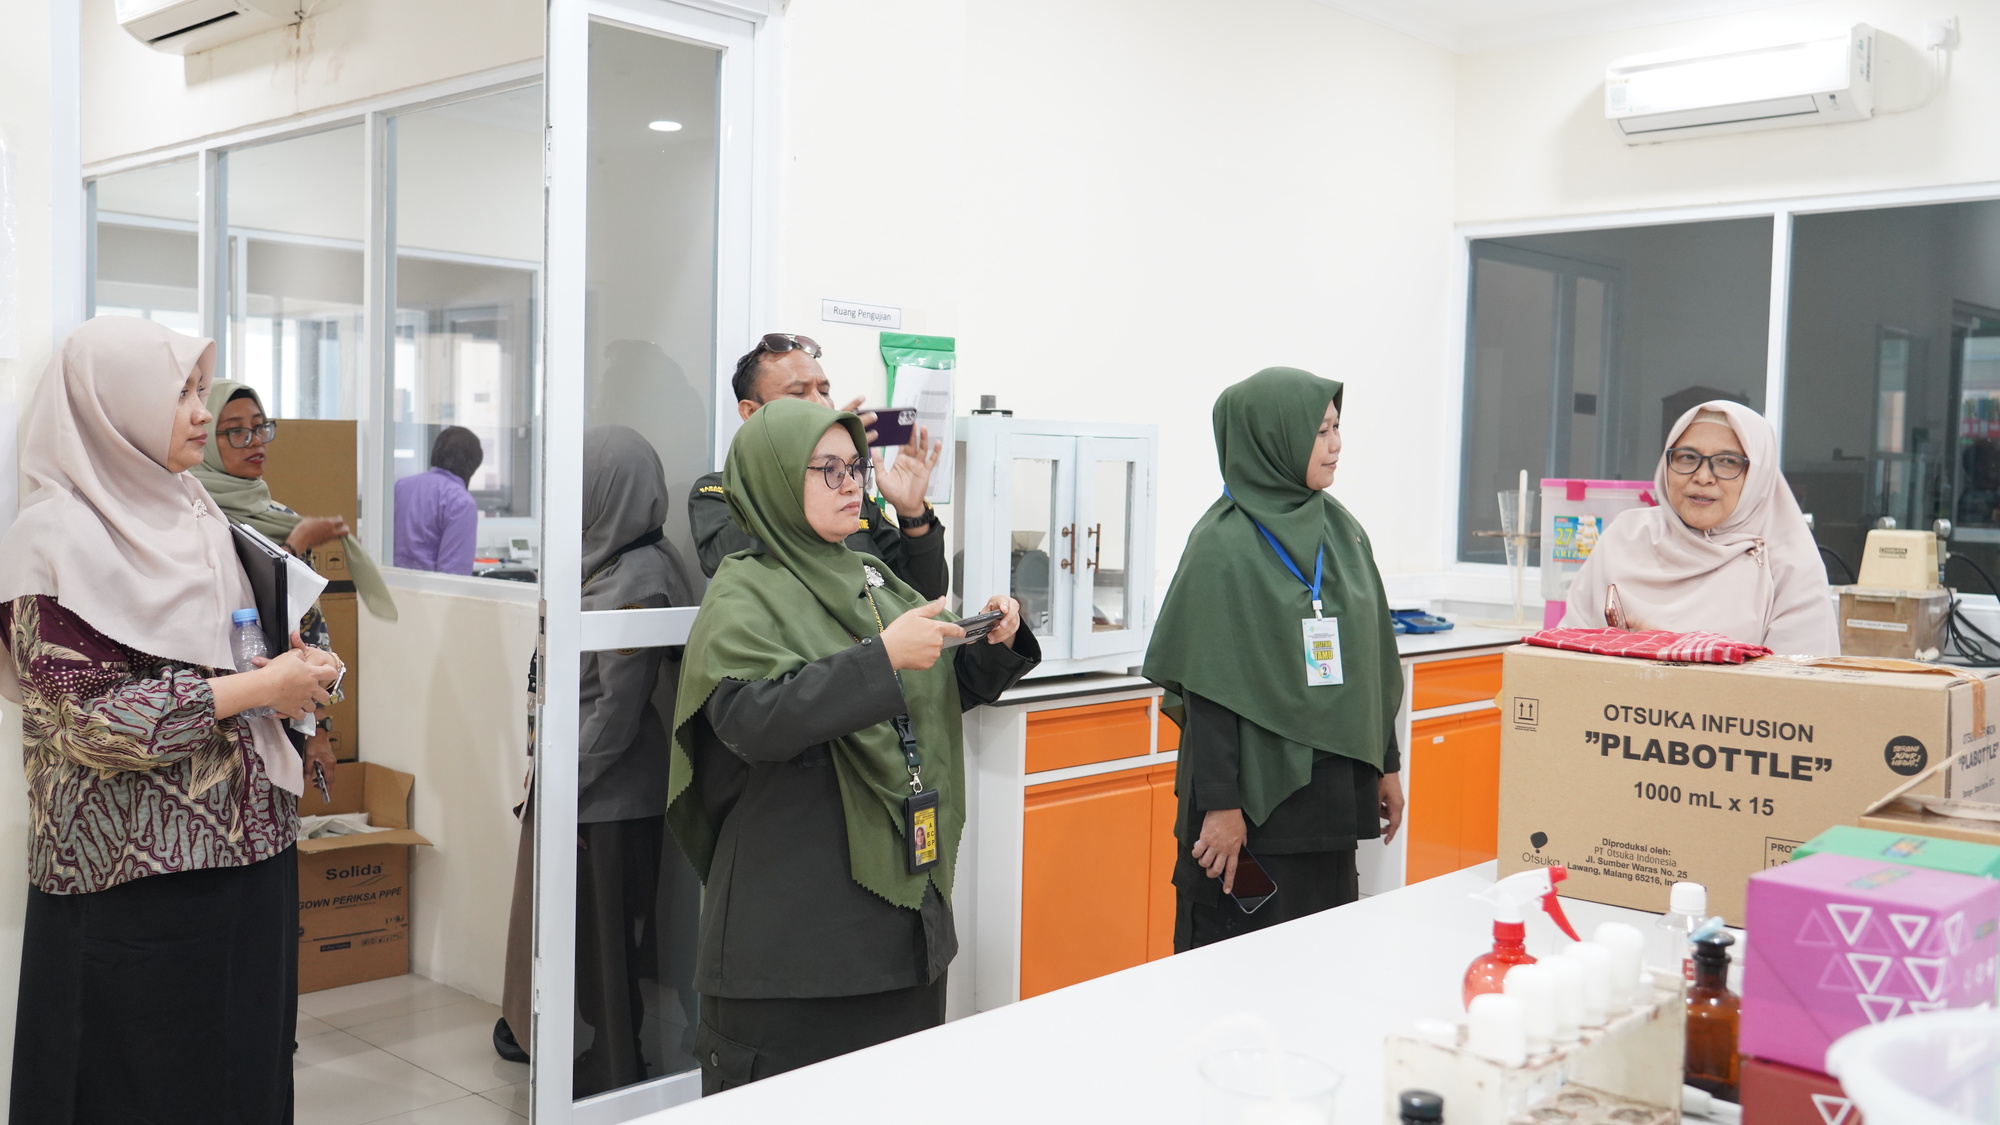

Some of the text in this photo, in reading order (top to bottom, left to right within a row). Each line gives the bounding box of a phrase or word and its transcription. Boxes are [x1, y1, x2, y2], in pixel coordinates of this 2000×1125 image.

[833, 306, 892, 322] Ruang Pengujian
[1313, 650, 1333, 661] TAMU
[1322, 666, 1328, 676] 2
[1603, 704, 1814, 743] OTSUKA INFUSION
[1634, 781, 1774, 816] 1000 mL x 15
[1602, 838, 1671, 856] Diproduksi oleh:
[1522, 852, 1560, 867] Otsuka
[1594, 847, 1677, 867] PT Otsuka Indonesia
[326, 864, 382, 880] Solida
[1567, 862, 1601, 876] Lawang,
[1603, 868, 1633, 881] Malang
[1635, 874, 1662, 885] 65216,
[1585, 855, 1688, 879] Jl. Sumber Waras No. 25
[299, 898, 330, 910] GOWN
[333, 892, 377, 905] PERIKSA
